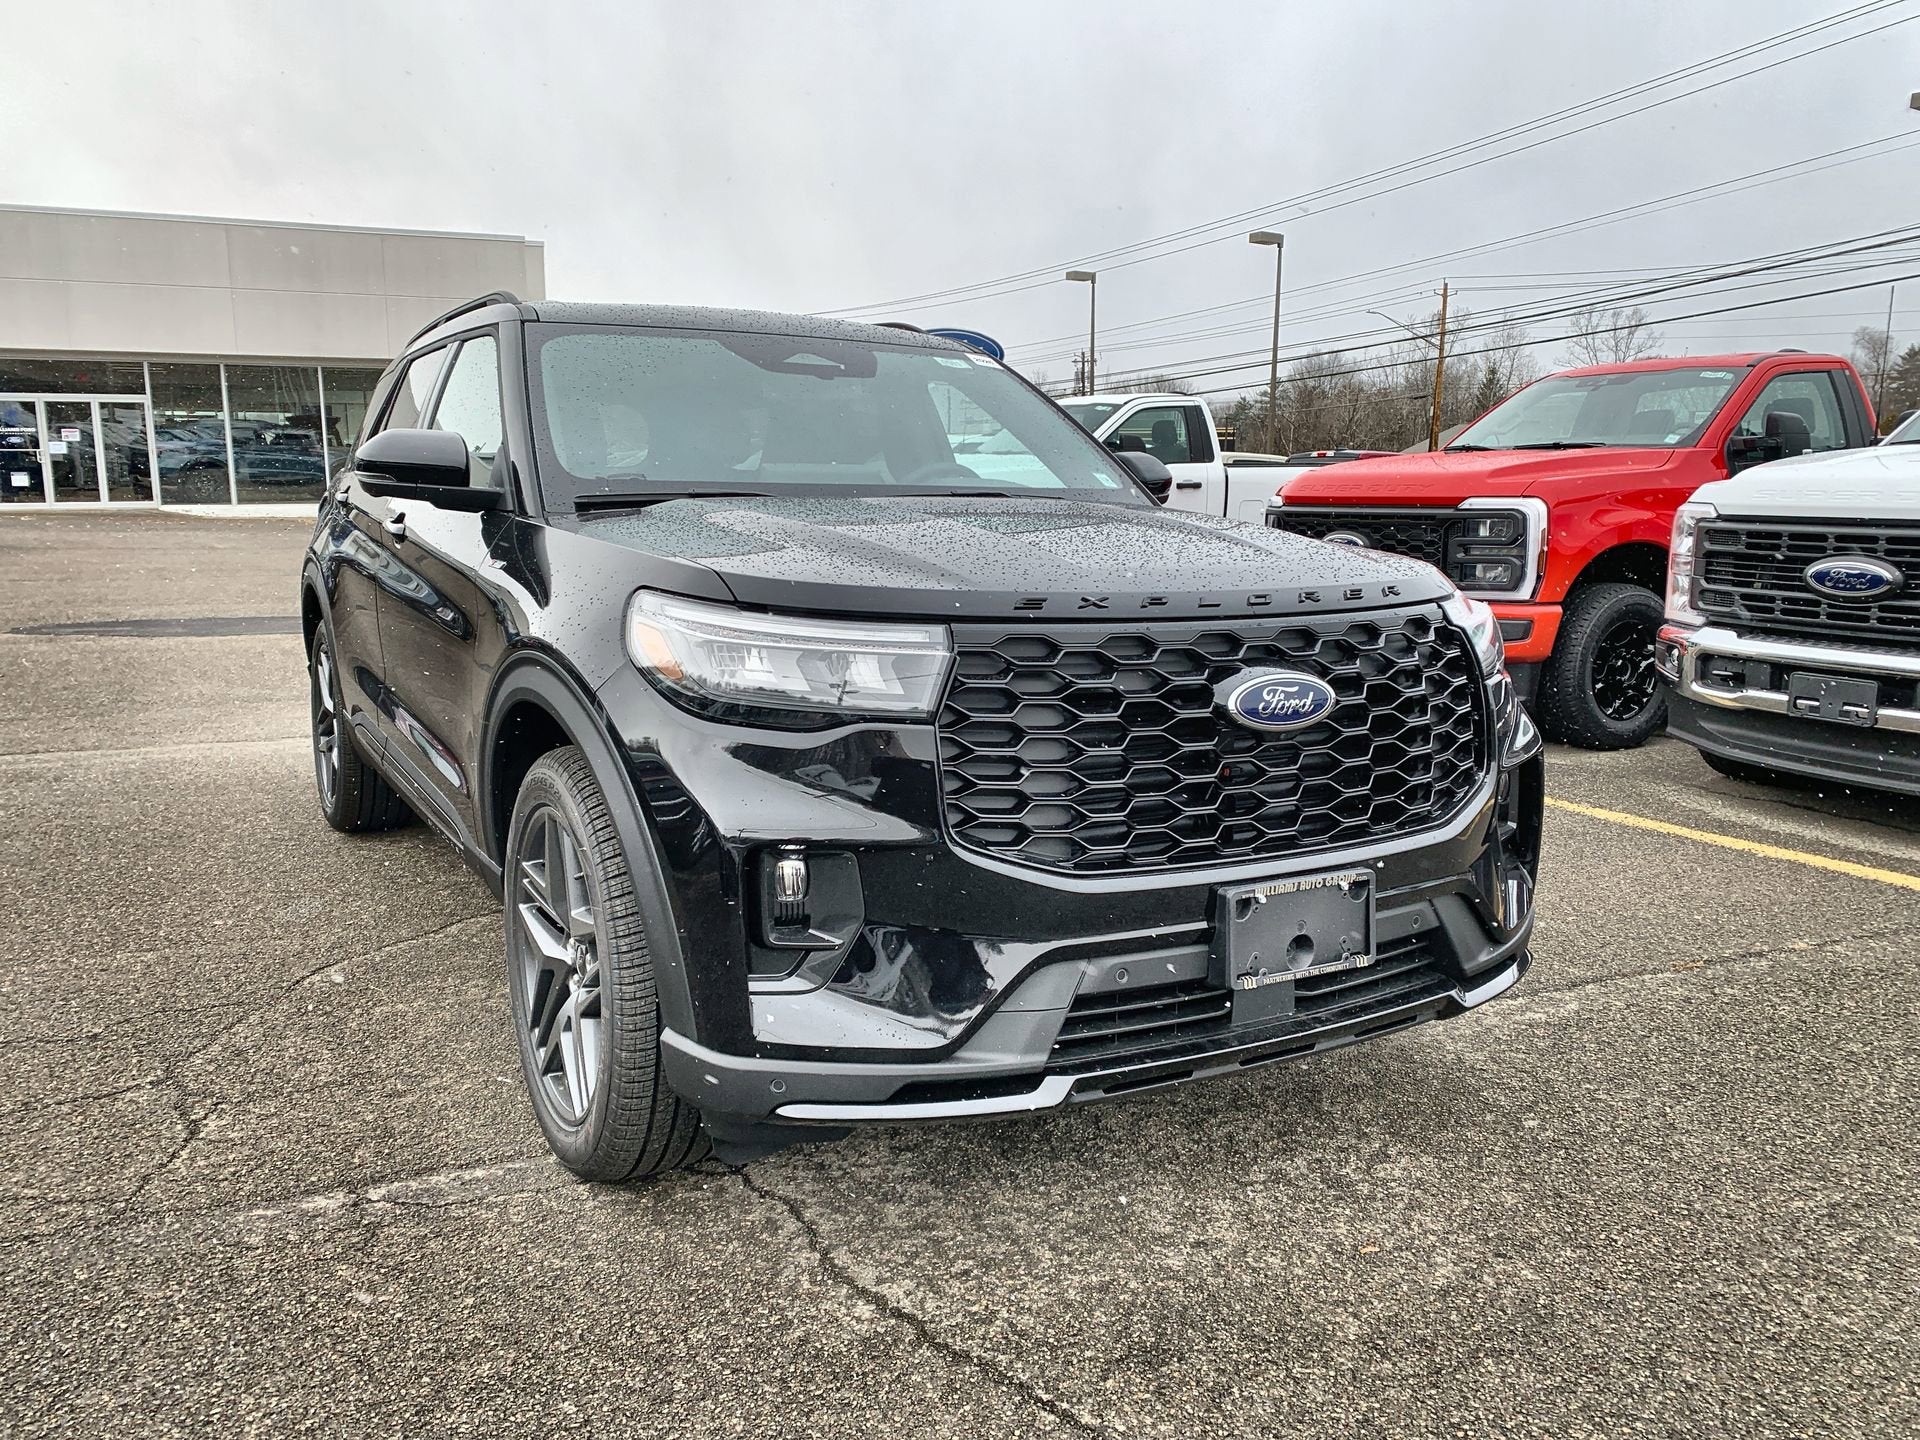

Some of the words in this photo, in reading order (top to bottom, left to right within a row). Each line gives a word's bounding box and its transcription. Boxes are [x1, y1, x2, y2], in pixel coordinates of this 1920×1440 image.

[1824, 568, 1871, 588] Ford
[1013, 585, 1401, 611] EXPLORER
[1258, 685, 1314, 717] Ford
[1300, 879, 1323, 891] AUTO
[1263, 974, 1295, 985] PARTNERING
[1296, 971, 1309, 979] WITH
